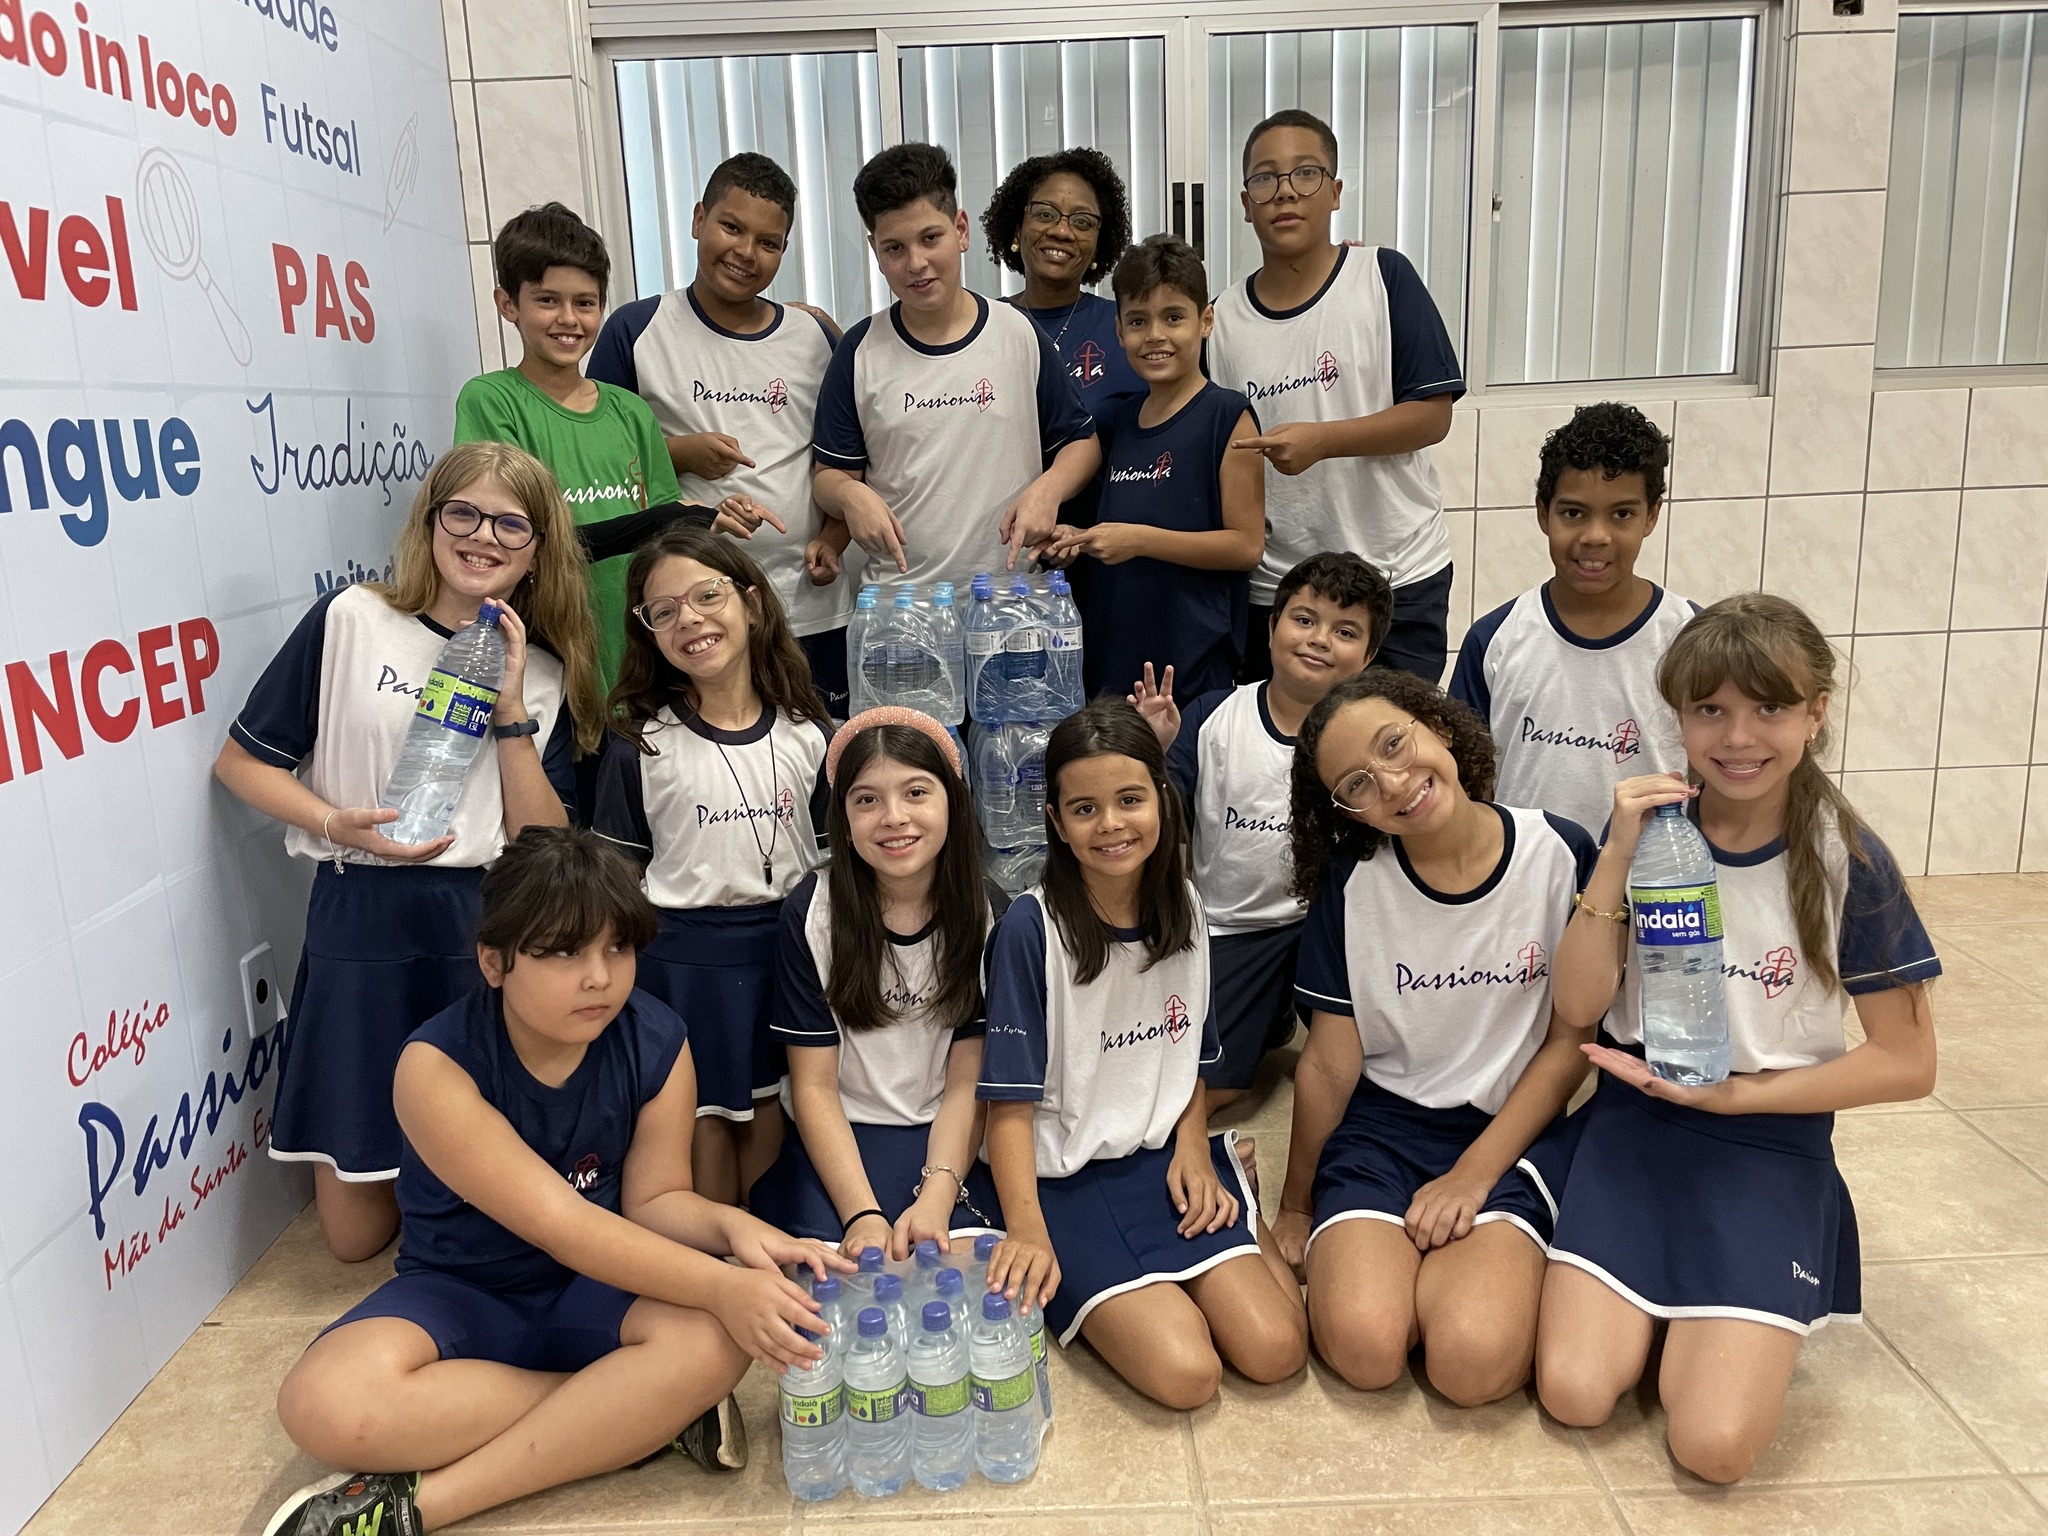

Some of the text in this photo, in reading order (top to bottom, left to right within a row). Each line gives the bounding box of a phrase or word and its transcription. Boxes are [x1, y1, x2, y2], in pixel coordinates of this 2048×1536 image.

[74, 1, 133, 102] in
[138, 34, 238, 137] loco
[259, 82, 362, 177] Futsal
[271, 242, 376, 344] PAS
[246, 391, 435, 507] Tradição
[1522, 716, 1641, 756] Passionista
[1224, 806, 1290, 833] Passio
[1395, 949, 1549, 996] Passionista
[67, 999, 170, 1087] Colégio
[104, 1230, 152, 1292] Mãe
[158, 1196, 186, 1244] da
[190, 1140, 248, 1212] Santa
